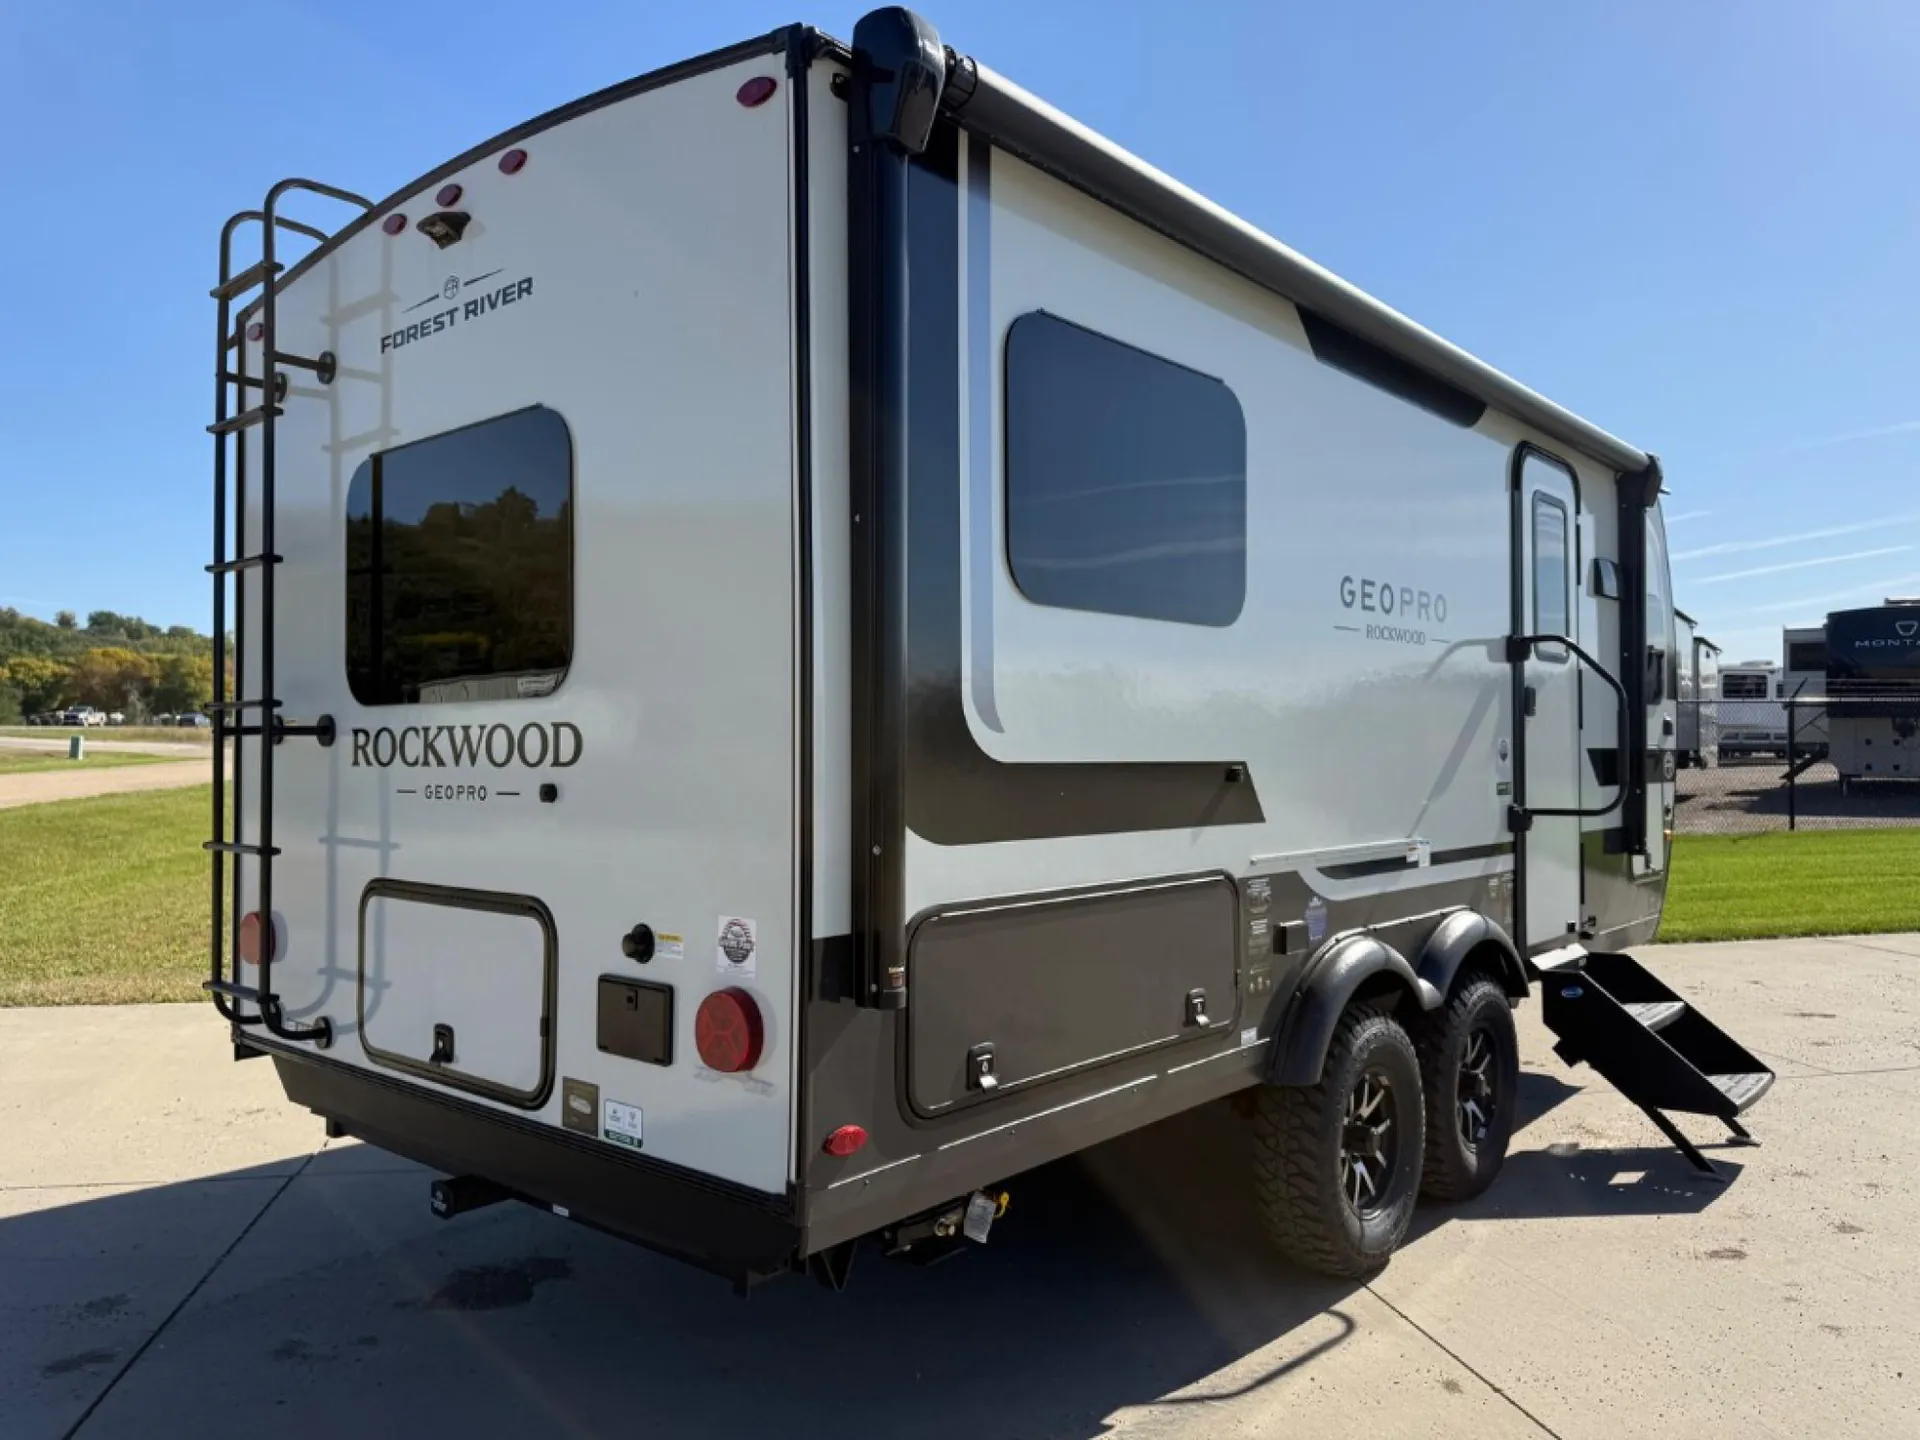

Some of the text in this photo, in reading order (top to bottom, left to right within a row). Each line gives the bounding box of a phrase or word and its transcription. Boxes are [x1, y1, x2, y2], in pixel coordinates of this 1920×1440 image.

[380, 276, 533, 354] FOREST RIVER
[1340, 575, 1447, 623] GEOPRO
[1366, 624, 1426, 645] ROCKWOOD
[351, 722, 583, 767] ROCKWOOD
[424, 784, 487, 801] GEOPRO
